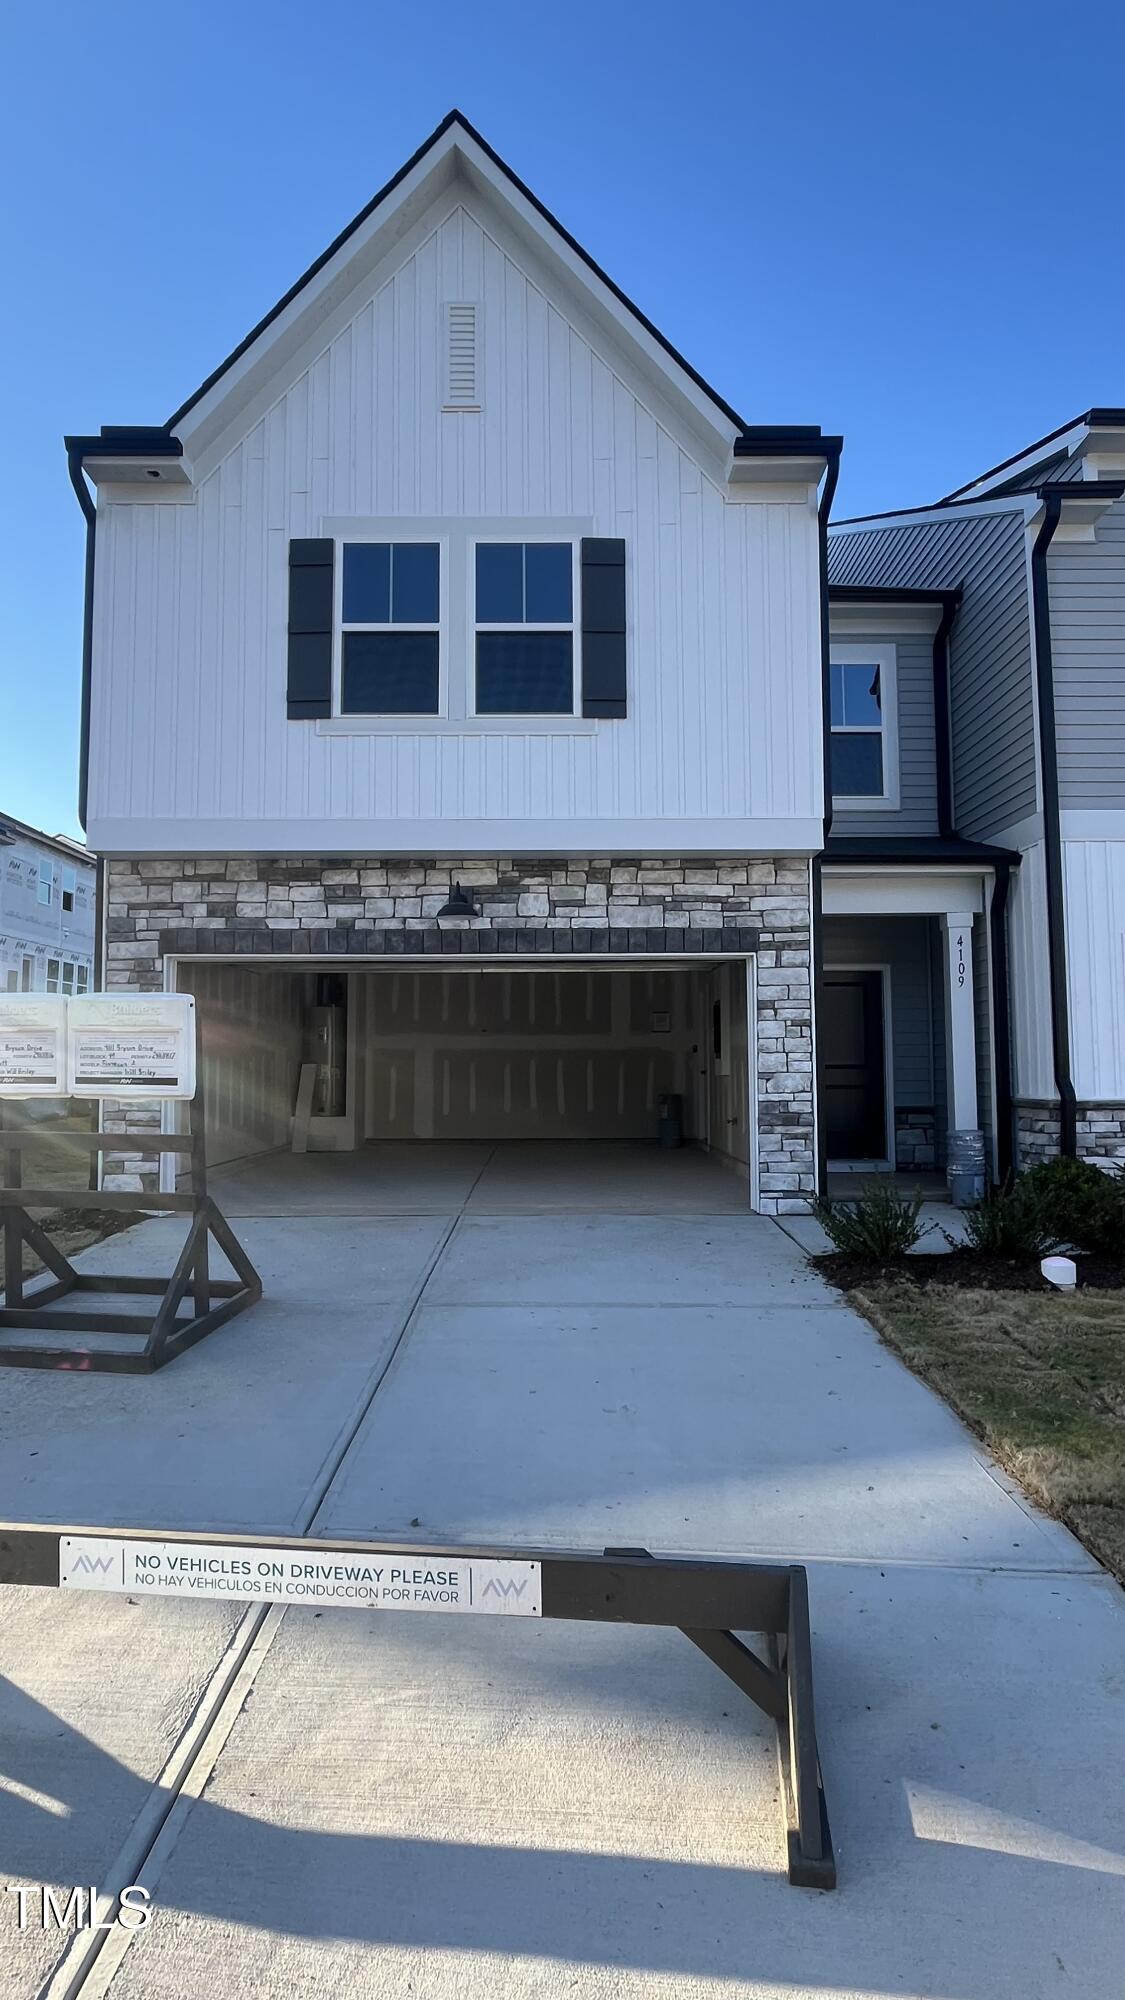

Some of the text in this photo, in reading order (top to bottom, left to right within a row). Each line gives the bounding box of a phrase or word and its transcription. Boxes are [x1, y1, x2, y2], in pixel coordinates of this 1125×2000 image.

[957, 935, 966, 988] 4109
[135, 1554, 459, 1586] NO VEHICLES ON DRIVEWAY PLEASE
[135, 1573, 459, 1603] NO HAY VEHICULOS EN CONDUCCION POR FAVOR
